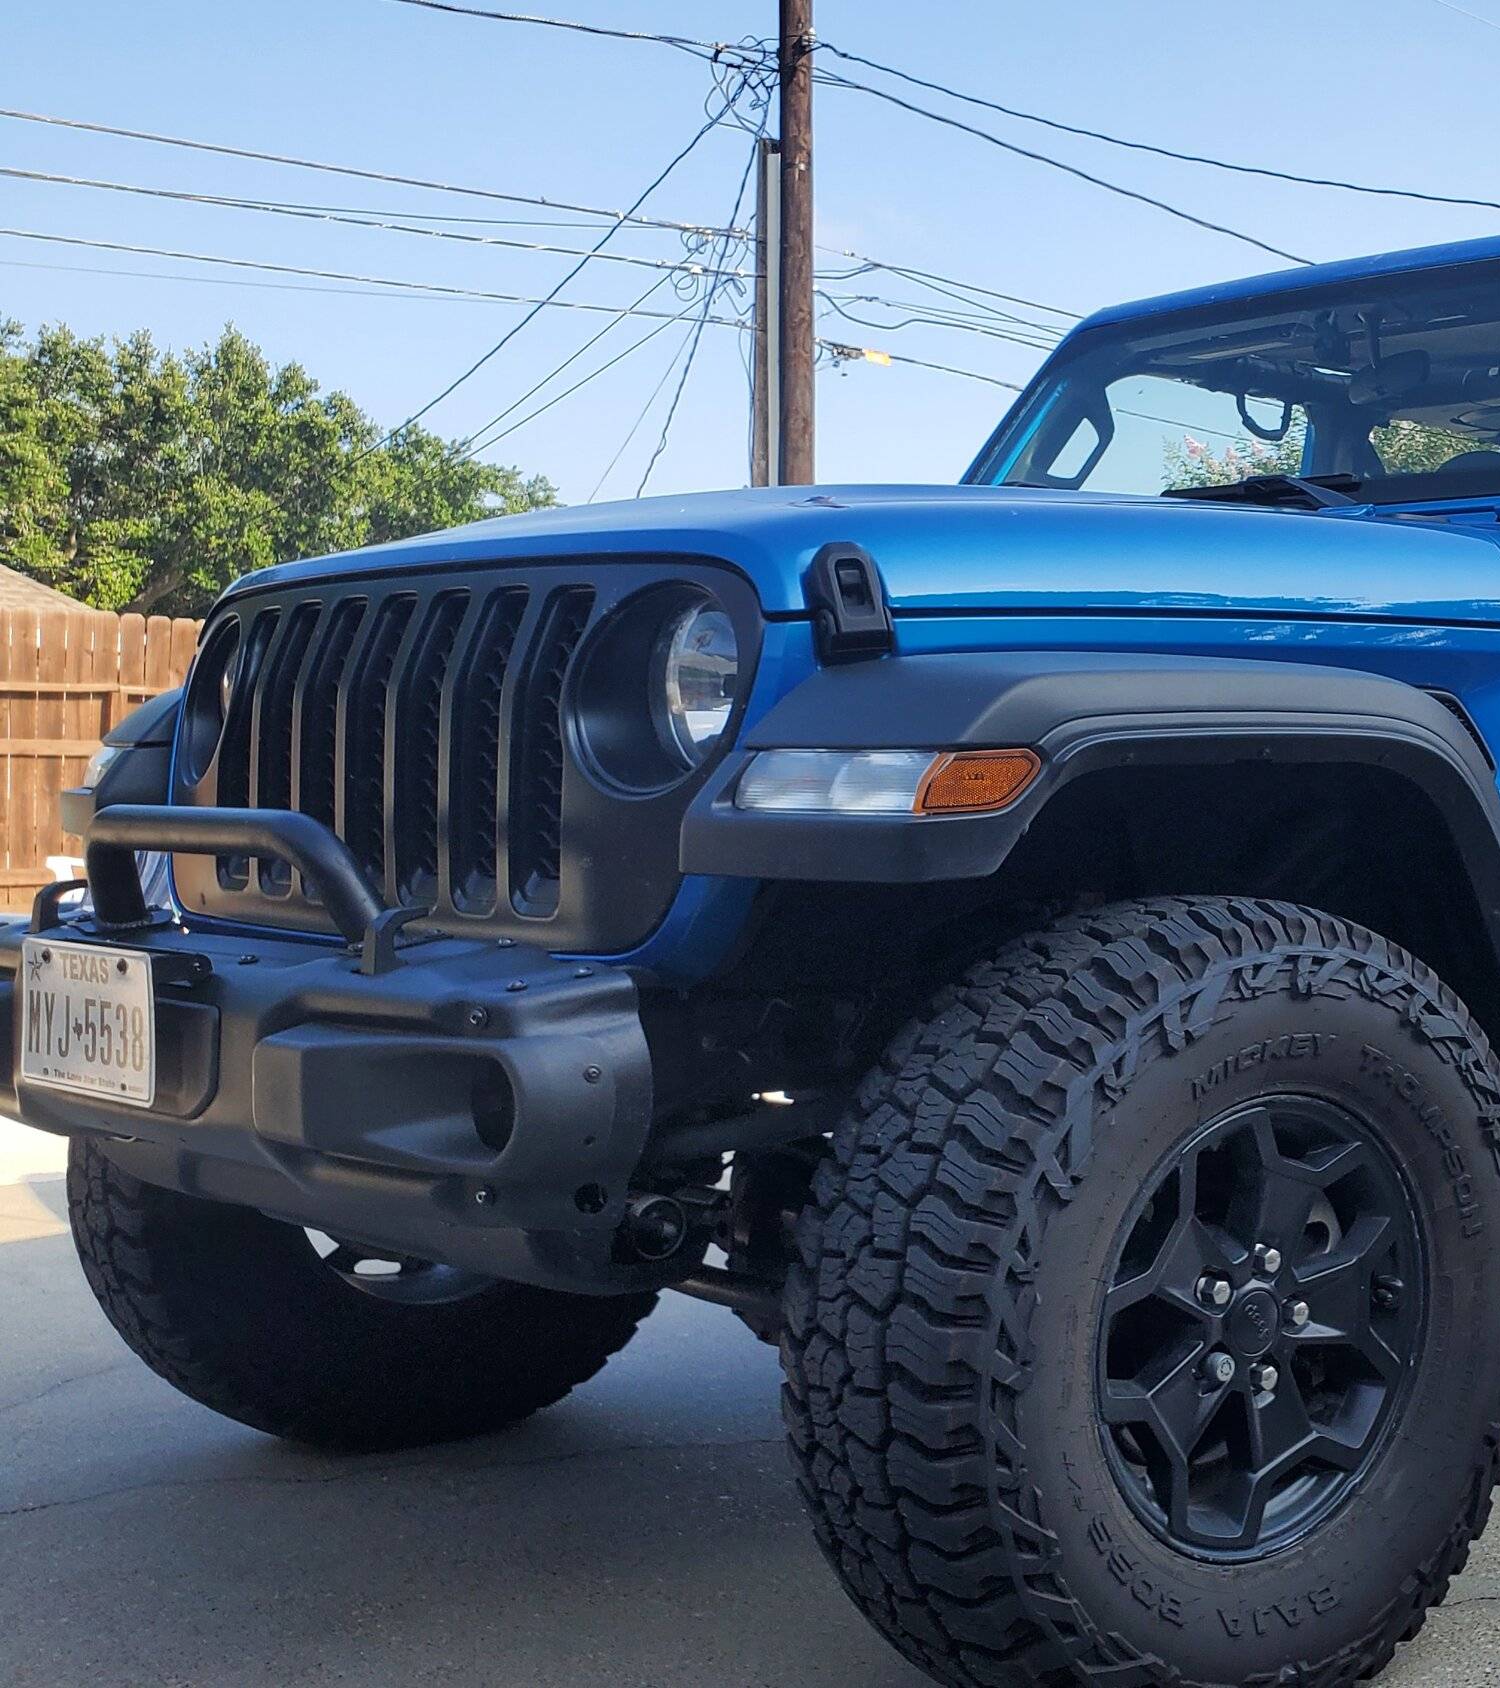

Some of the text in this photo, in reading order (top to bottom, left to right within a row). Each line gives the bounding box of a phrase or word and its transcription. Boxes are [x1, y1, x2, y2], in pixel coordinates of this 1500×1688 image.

[60, 952, 109, 985] TEXAS
[1190, 1032, 1340, 1102] MICKEY
[1087, 1516, 1342, 1638] BAJA BOSS
